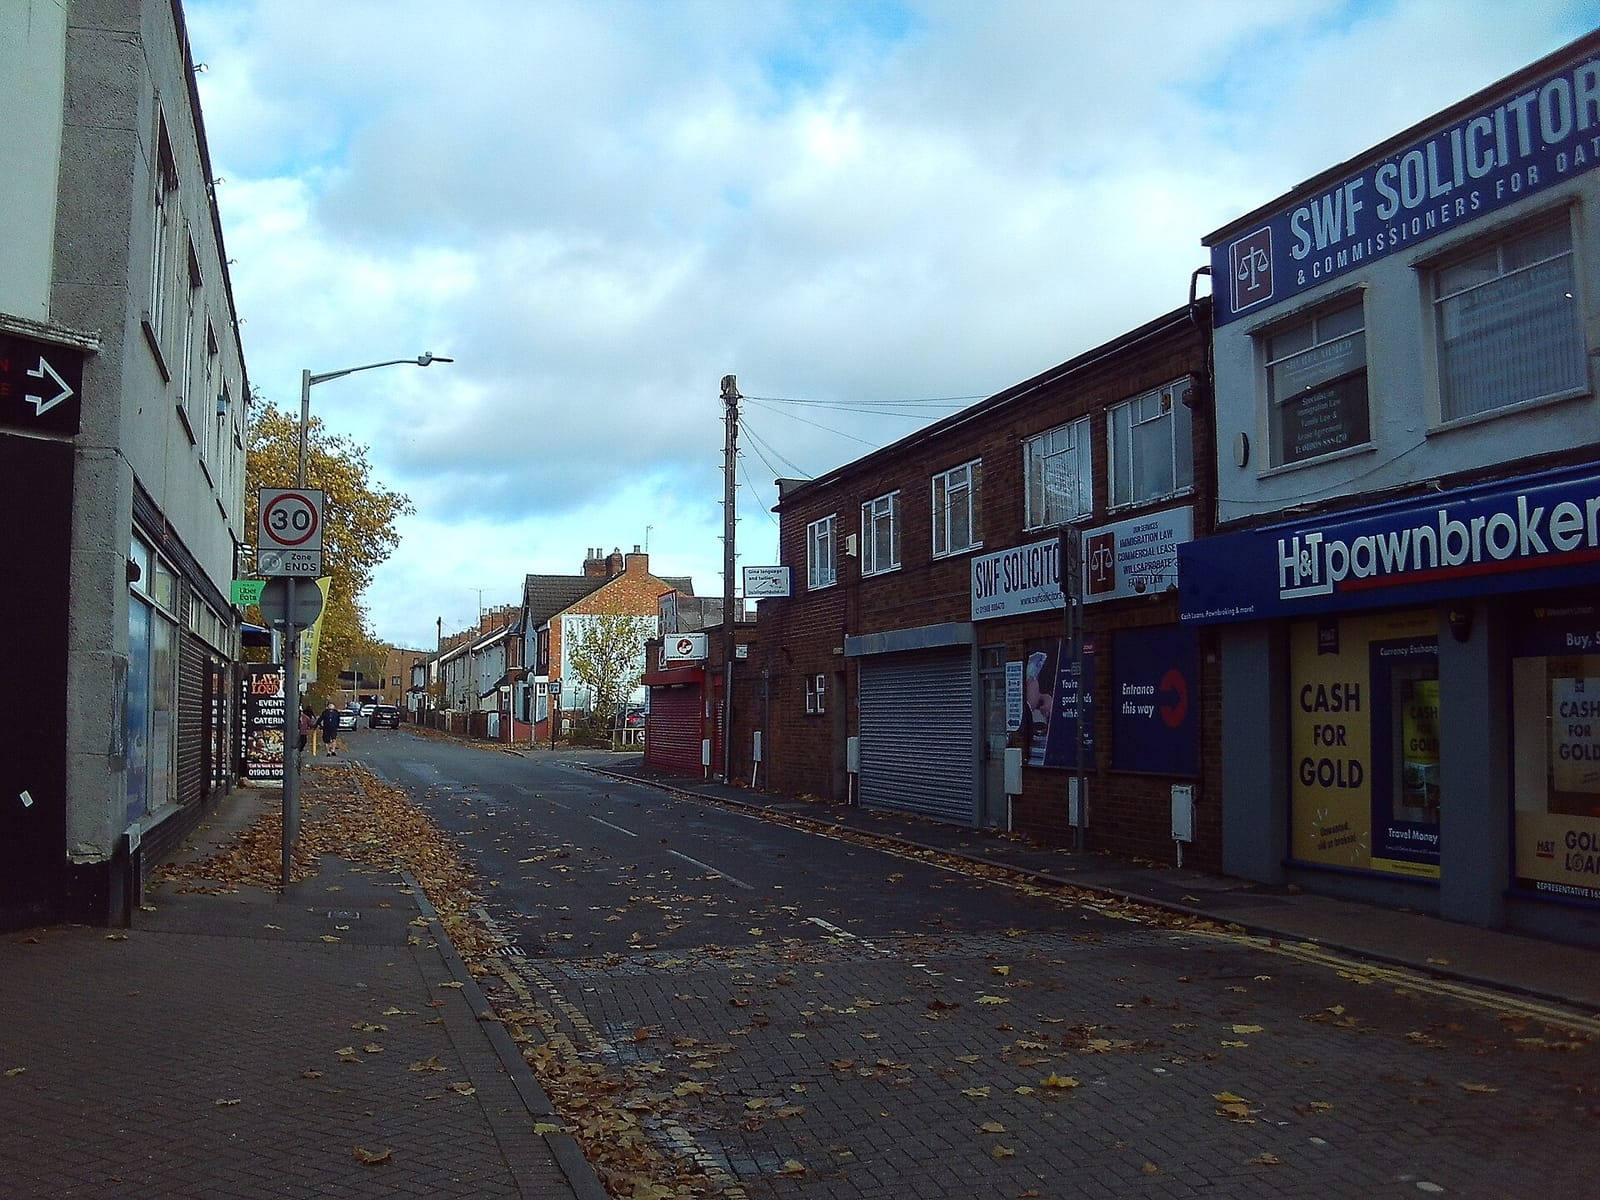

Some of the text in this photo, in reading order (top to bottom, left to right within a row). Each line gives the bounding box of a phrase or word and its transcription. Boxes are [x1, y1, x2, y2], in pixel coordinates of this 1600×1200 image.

[1290, 61, 1600, 261] SWF SOLICITOR
[1297, 269, 1306, 286] &
[1312, 191, 1481, 279] COMMISSIONERS
[1496, 165, 1539, 200] FOR
[271, 509, 310, 530] 30
[1120, 529, 1174, 548] IMMIGRATION LAW
[291, 553, 312, 561] Zone
[1117, 547, 1156, 562] COMMERCIAL
[1278, 532, 1323, 588] H&T
[285, 562, 317, 571] ENDS
[976, 558, 1000, 599] SWF
[1380, 647, 1409, 657] Currency
[1122, 683, 1155, 696] Entrance
[1300, 682, 1360, 713] CASH
[1062, 693, 1076, 706] good
[1122, 701, 1155, 719] this way
[1560, 701, 1600, 718] CASH
[1313, 723, 1347, 747] FOR
[1568, 724, 1592, 737] FOR
[1560, 743, 1600, 761] GOLD
[249, 769, 271, 777] 01908
[1300, 757, 1363, 789] GOLD
[1388, 827, 1439, 845] Travel Money
[1536, 840, 1555, 852] H&T
[1535, 881, 1590, 897] REPRESENTATIVE
